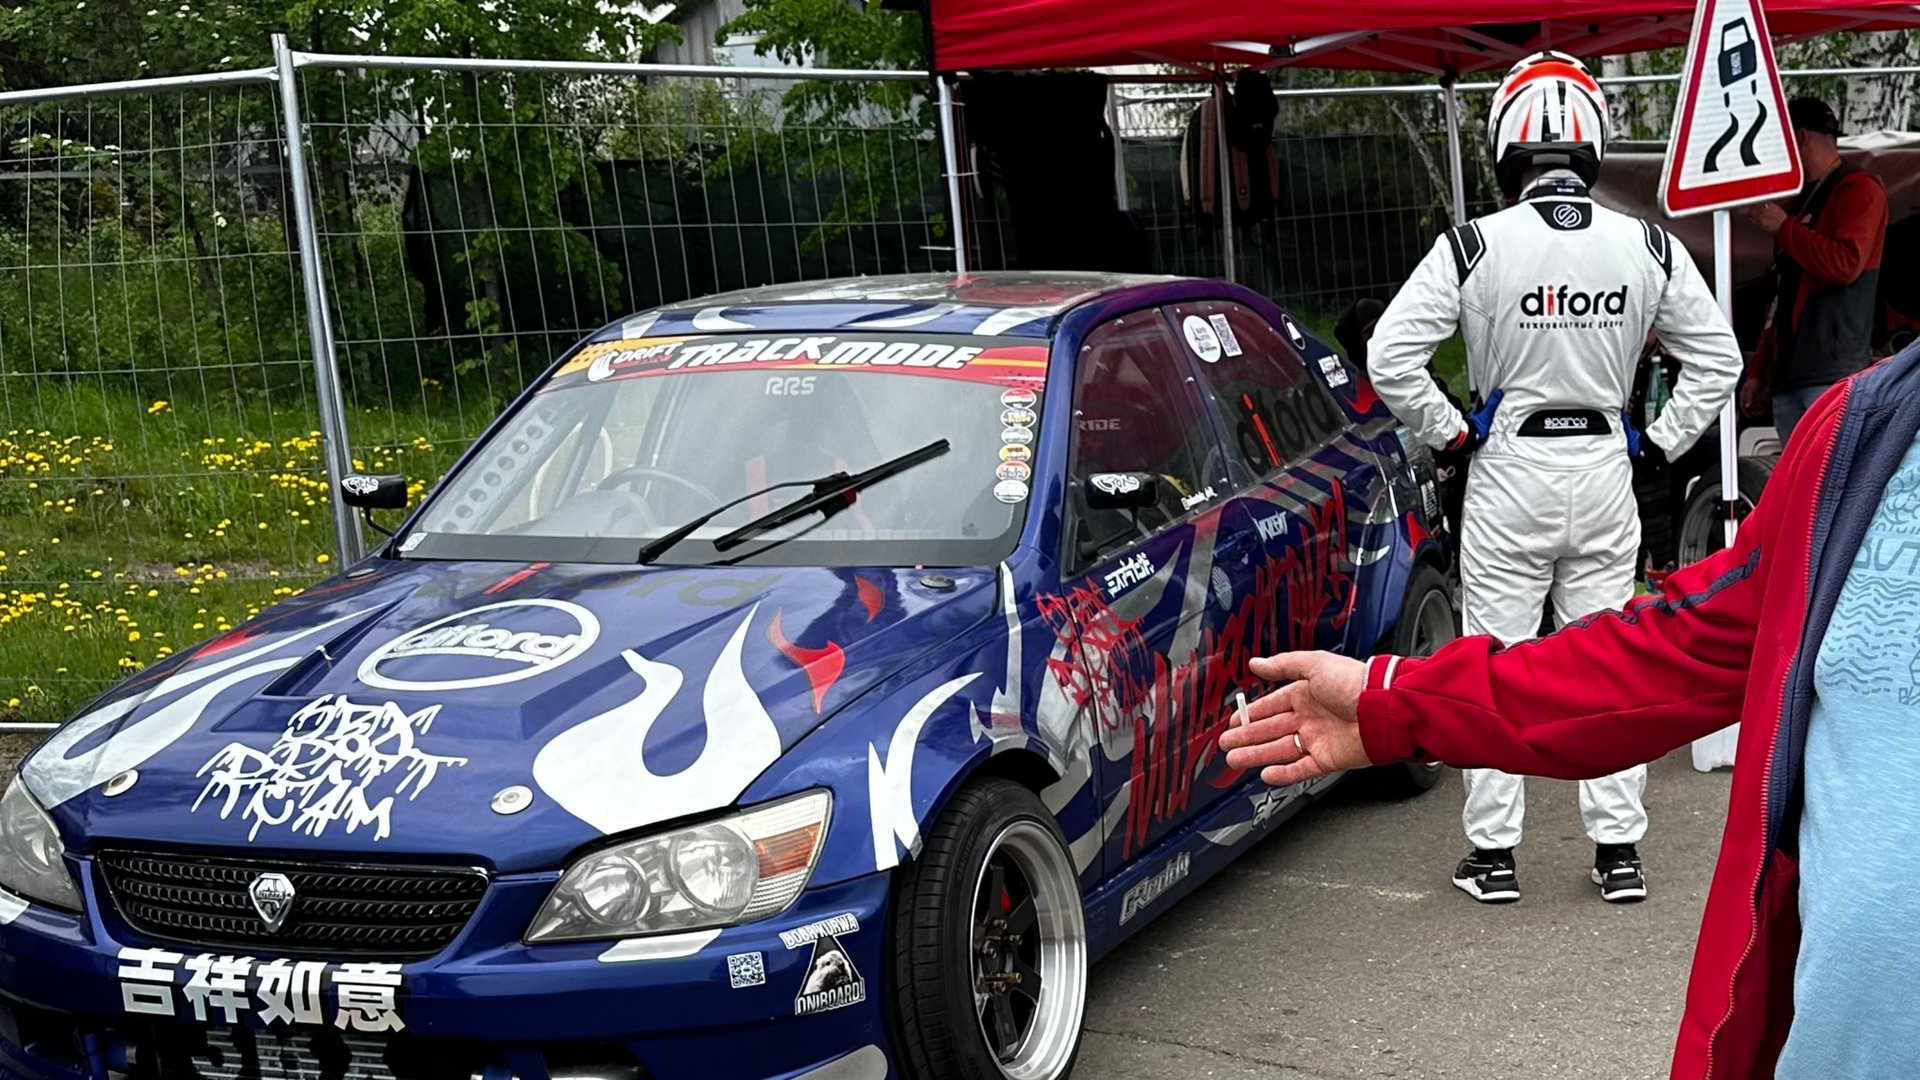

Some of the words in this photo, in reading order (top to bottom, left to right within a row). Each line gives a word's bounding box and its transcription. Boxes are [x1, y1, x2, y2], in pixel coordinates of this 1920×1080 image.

[1520, 284, 1628, 317] diford
[614, 343, 683, 363] DRIFT
[818, 346, 983, 369] MODE
[764, 376, 817, 396] RRS
[1544, 417, 1588, 430] sparco
[395, 624, 578, 664] diford
[817, 914, 859, 938] KURWA
[117, 947, 405, 1033] 吉祥如意
